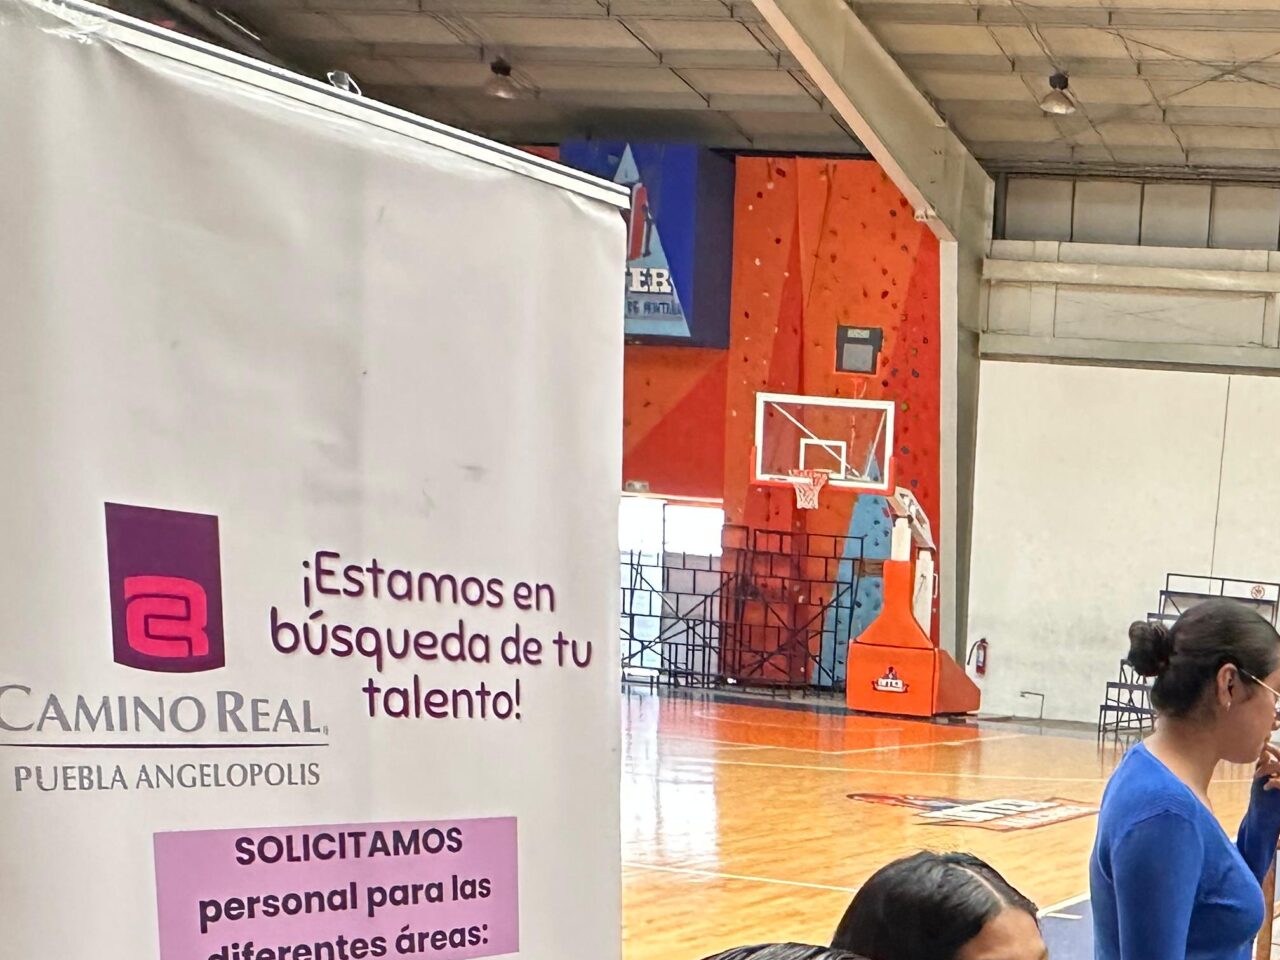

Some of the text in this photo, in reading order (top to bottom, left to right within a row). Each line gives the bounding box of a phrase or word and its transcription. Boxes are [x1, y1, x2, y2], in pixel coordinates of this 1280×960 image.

[625, 267, 672, 293] ER
[302, 550, 556, 612] ¡Estamos en
[269, 606, 593, 672] búsqueda de tu
[0, 684, 323, 733] CAMINO REAL
[362, 673, 522, 720] talento!
[14, 762, 321, 792] PUEBLA ANGELOPOLIS
[235, 826, 464, 866] SOLICITAMOS
[199, 874, 492, 934] personal para las
[395, 923, 489, 955] áreas:
